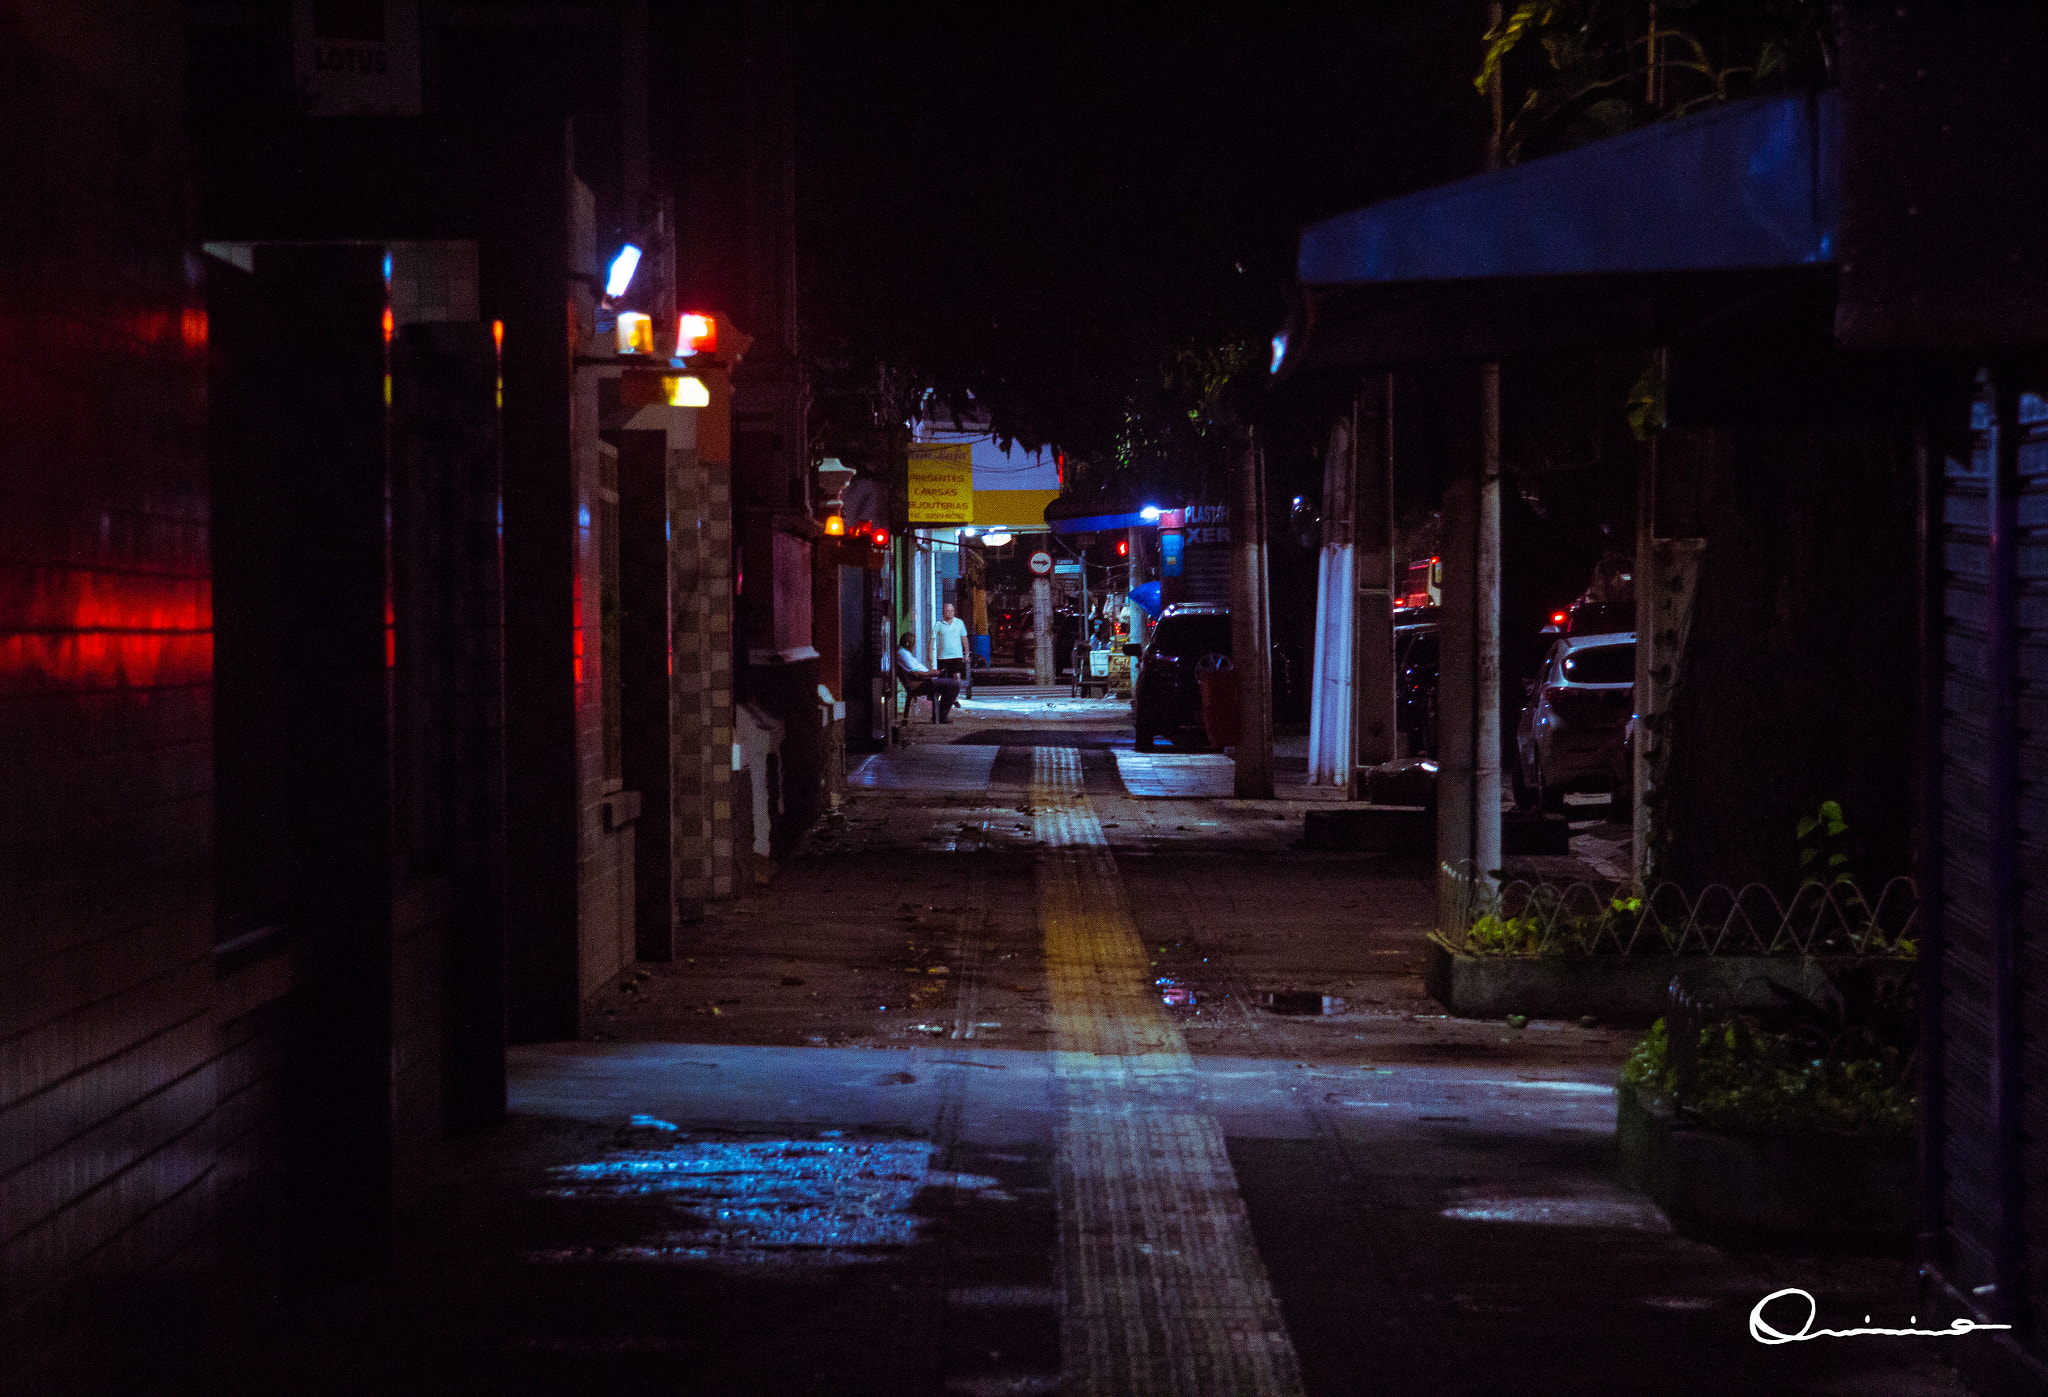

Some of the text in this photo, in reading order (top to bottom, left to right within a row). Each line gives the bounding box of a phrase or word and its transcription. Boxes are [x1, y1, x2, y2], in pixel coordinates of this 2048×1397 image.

[314, 47, 387, 74] LOTUS
[909, 474, 965, 482] PRESENTES
[914, 488, 958, 496] CAMISAS
[908, 501, 968, 510] BIJOUTERIAS
